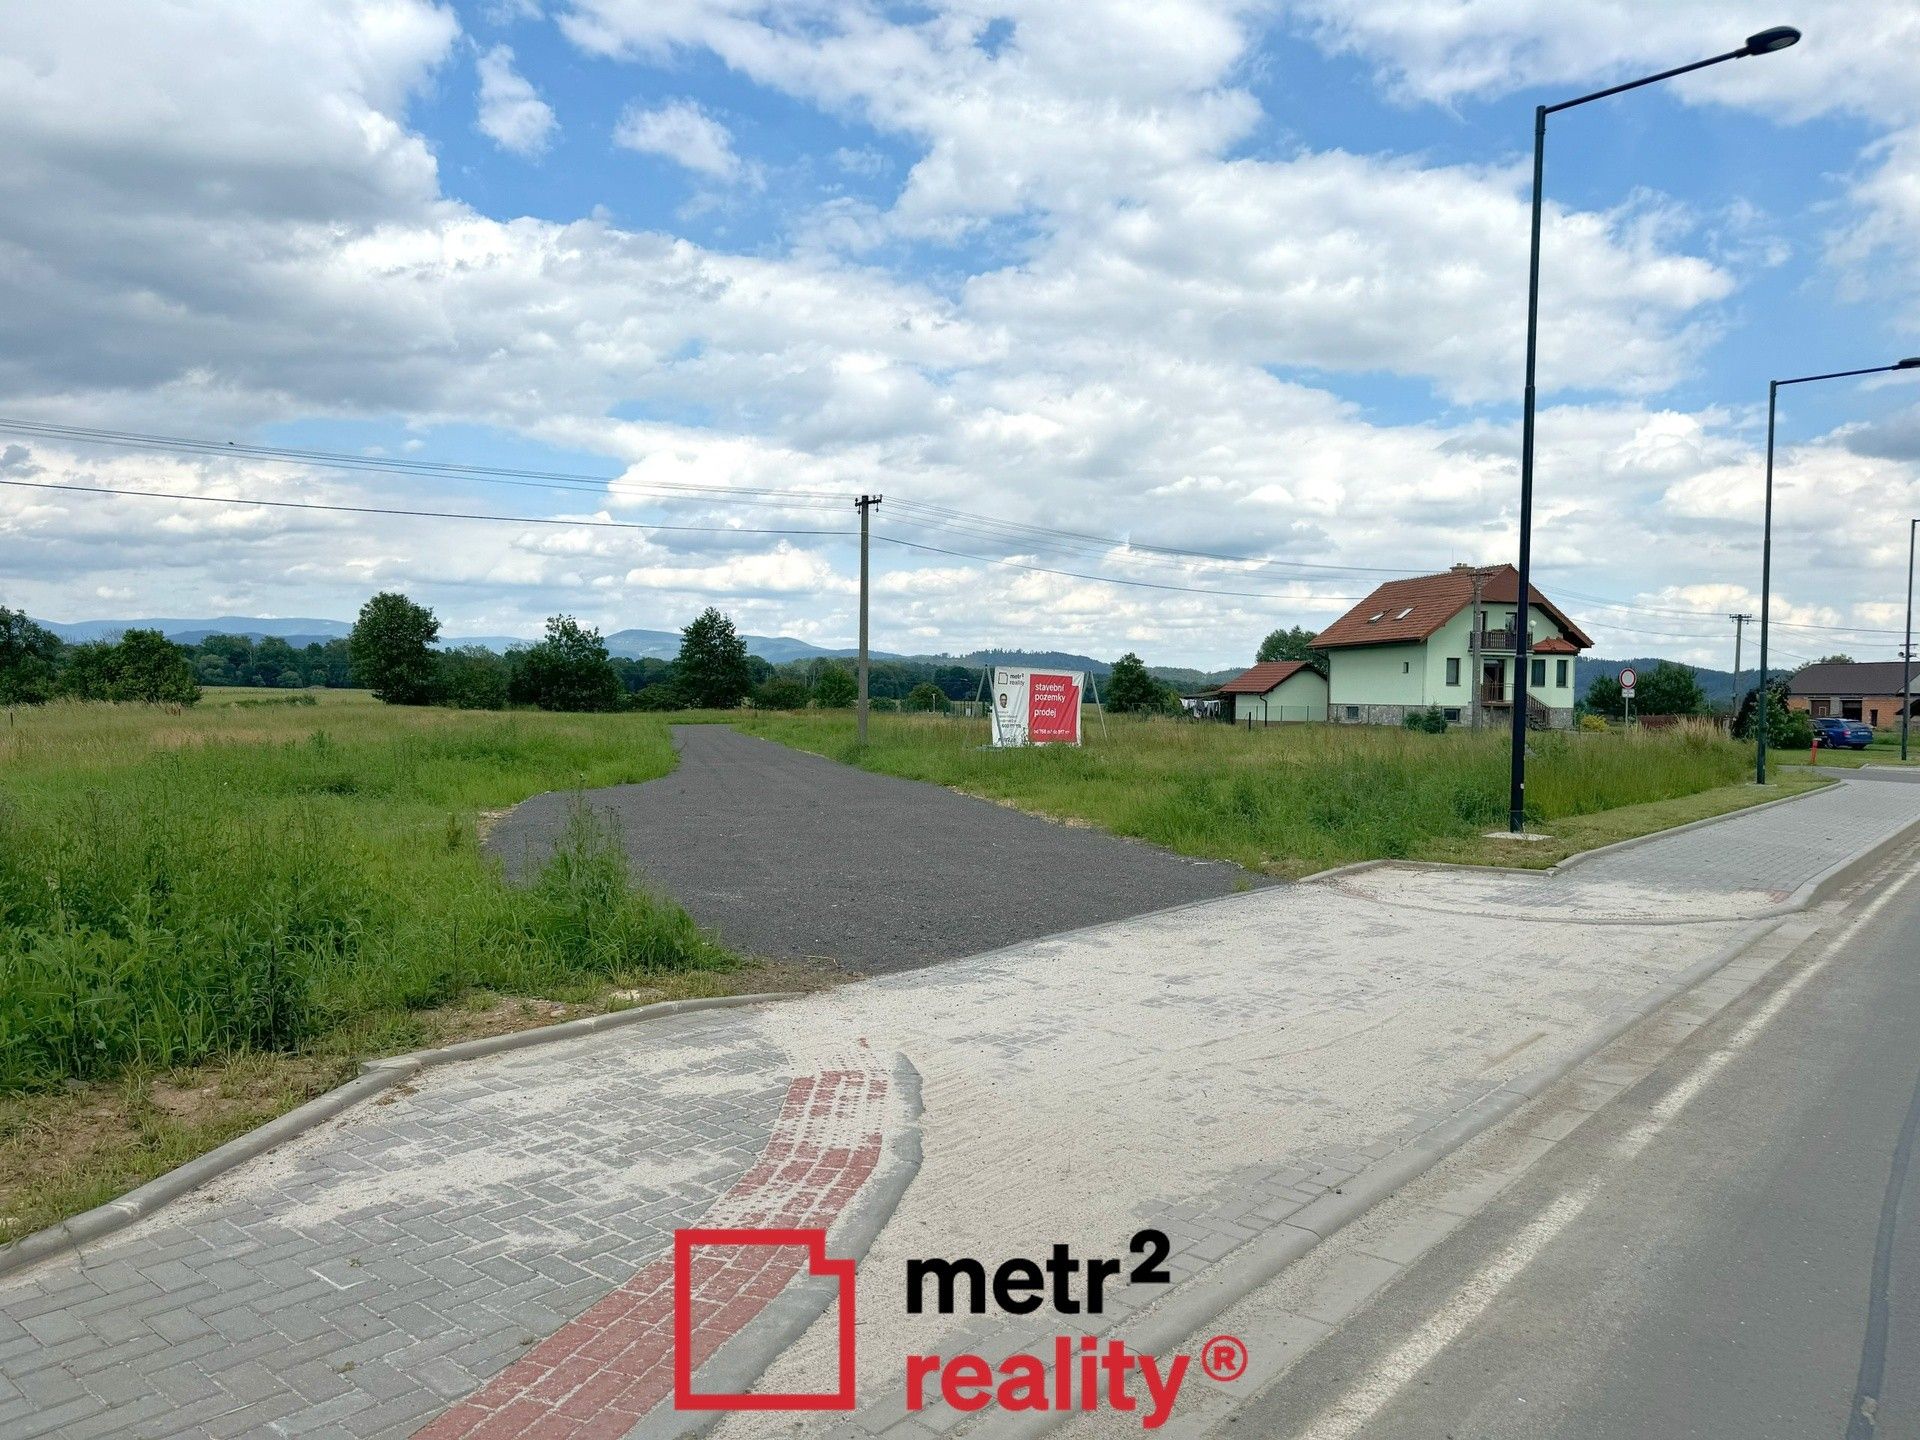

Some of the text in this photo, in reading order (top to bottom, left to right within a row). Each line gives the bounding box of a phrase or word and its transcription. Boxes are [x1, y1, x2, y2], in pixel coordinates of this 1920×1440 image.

[1035, 683, 1065, 692] stavební
[1034, 693, 1066, 703] pozemky
[1034, 708, 1057, 718] prodej
